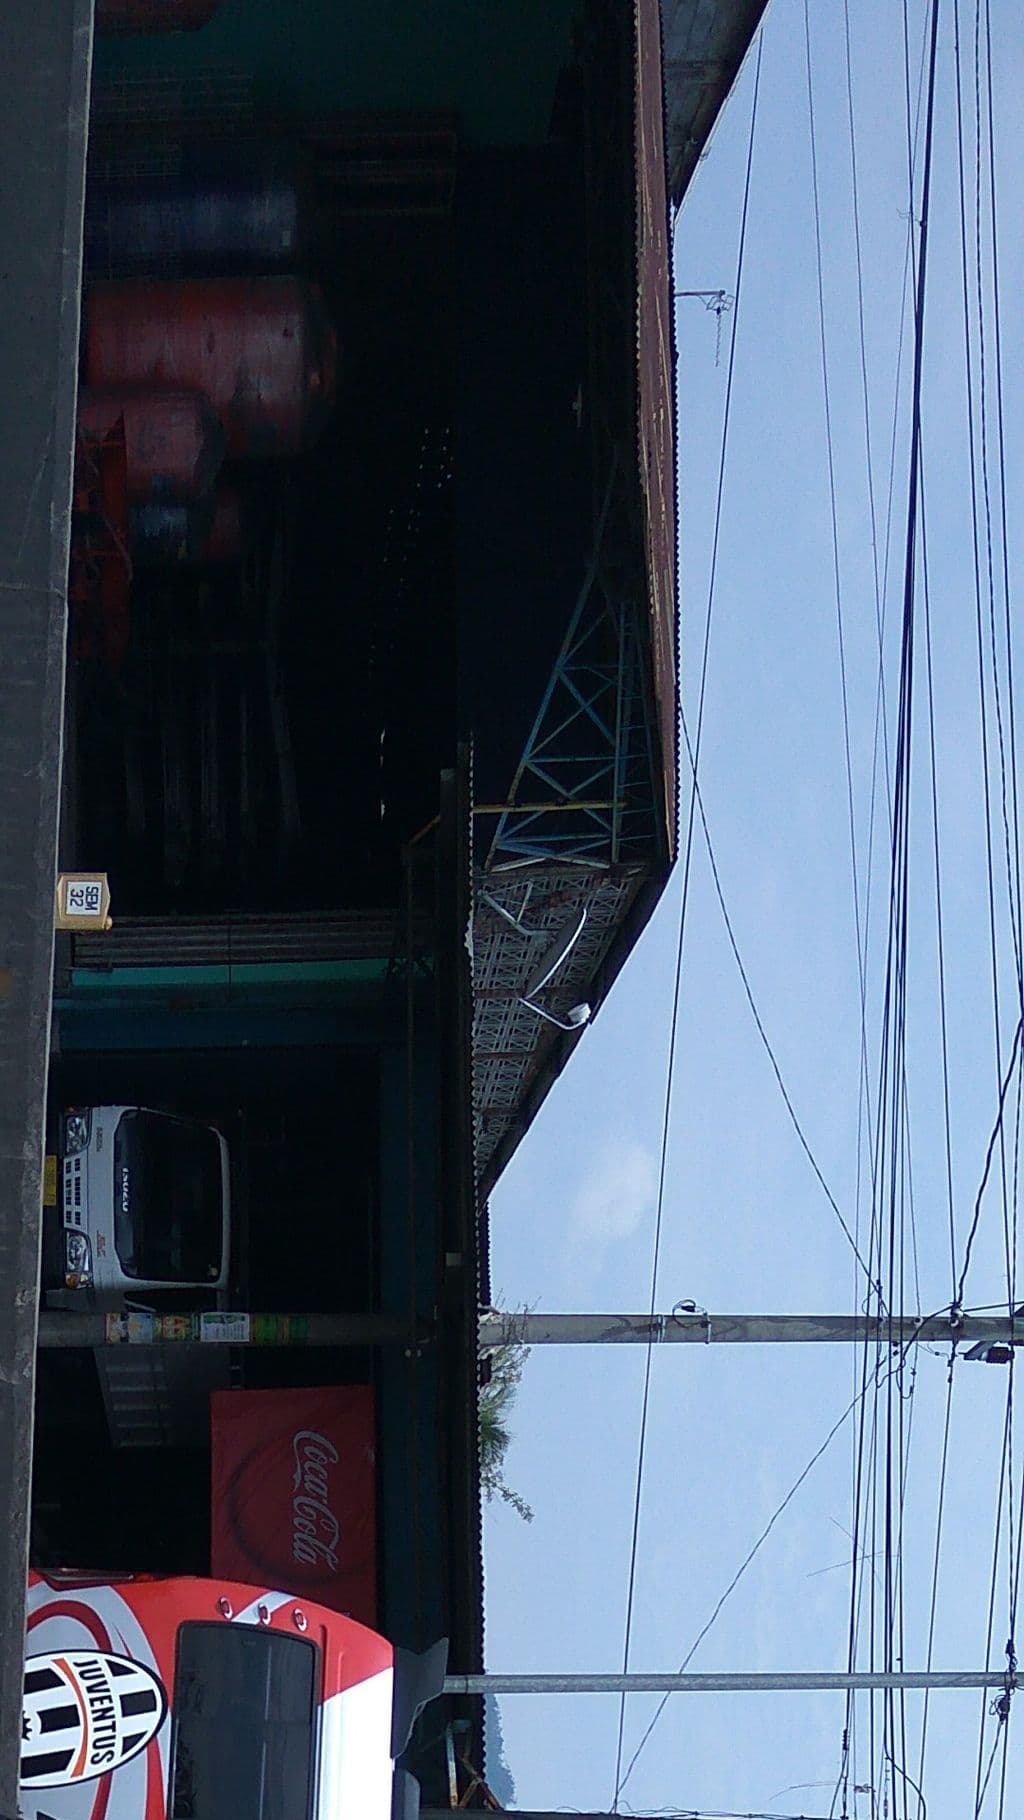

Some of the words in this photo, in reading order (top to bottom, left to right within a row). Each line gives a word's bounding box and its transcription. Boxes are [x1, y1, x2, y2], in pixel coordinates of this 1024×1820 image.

[70, 888, 84, 907] 32
[85, 886, 99, 911] SEM
[290, 1430, 341, 1571] Coca-Cola
[73, 1659, 116, 1765] JUVENTUS
